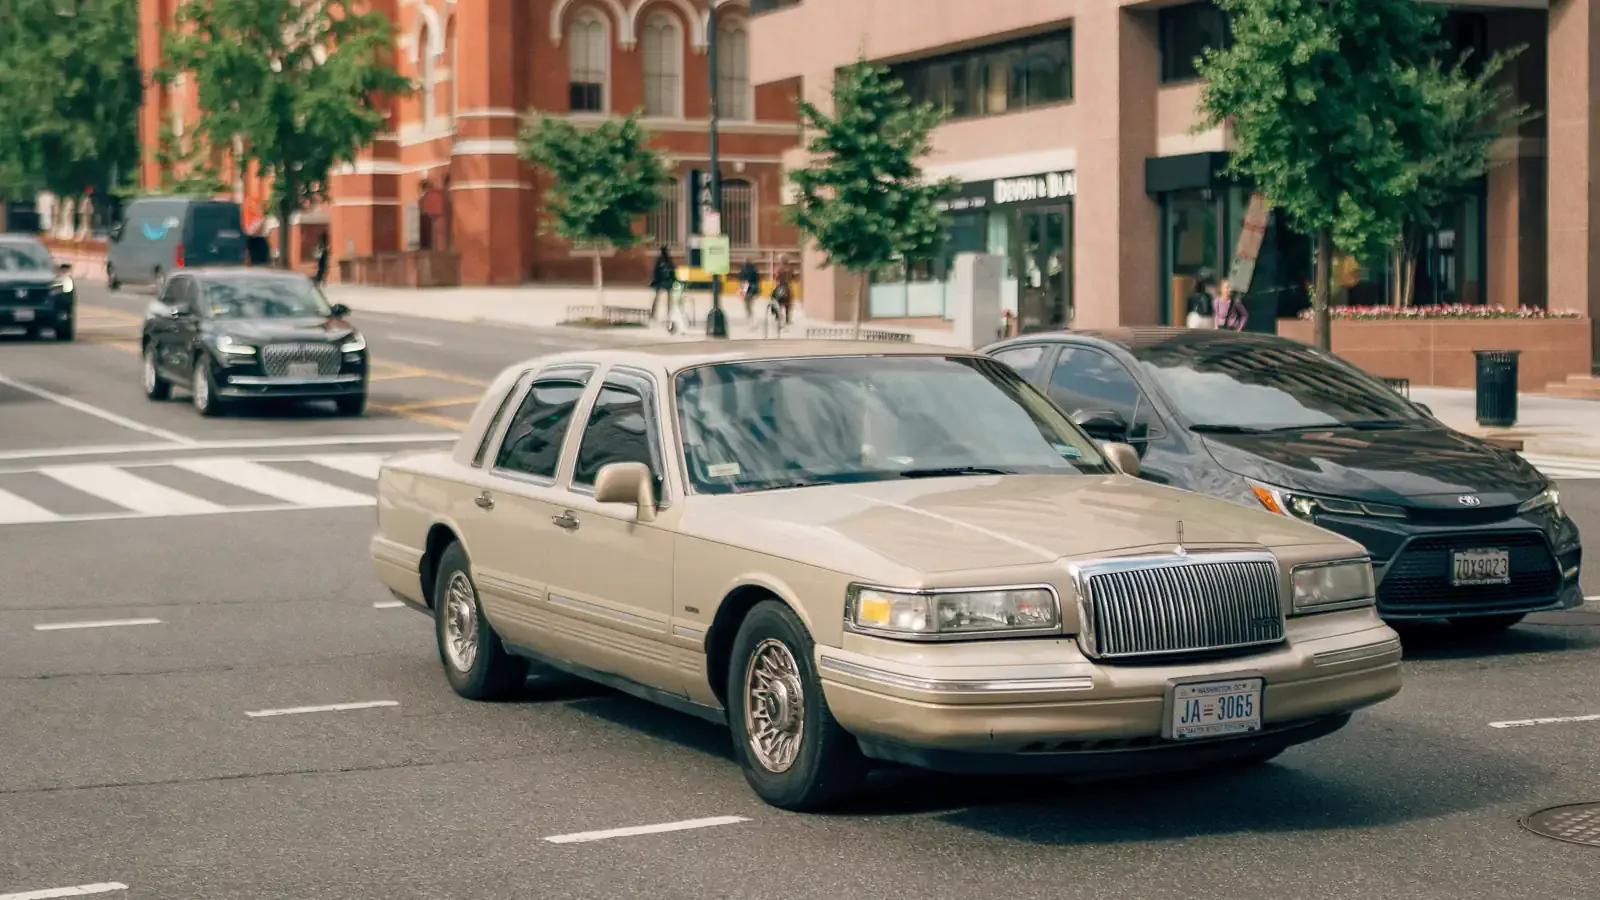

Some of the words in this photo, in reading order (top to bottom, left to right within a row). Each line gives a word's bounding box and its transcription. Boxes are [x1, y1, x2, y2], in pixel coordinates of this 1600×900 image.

[994, 177, 1036, 204] DEVON
[1181, 699, 1201, 723] JA
[1217, 694, 1253, 720] 3065
